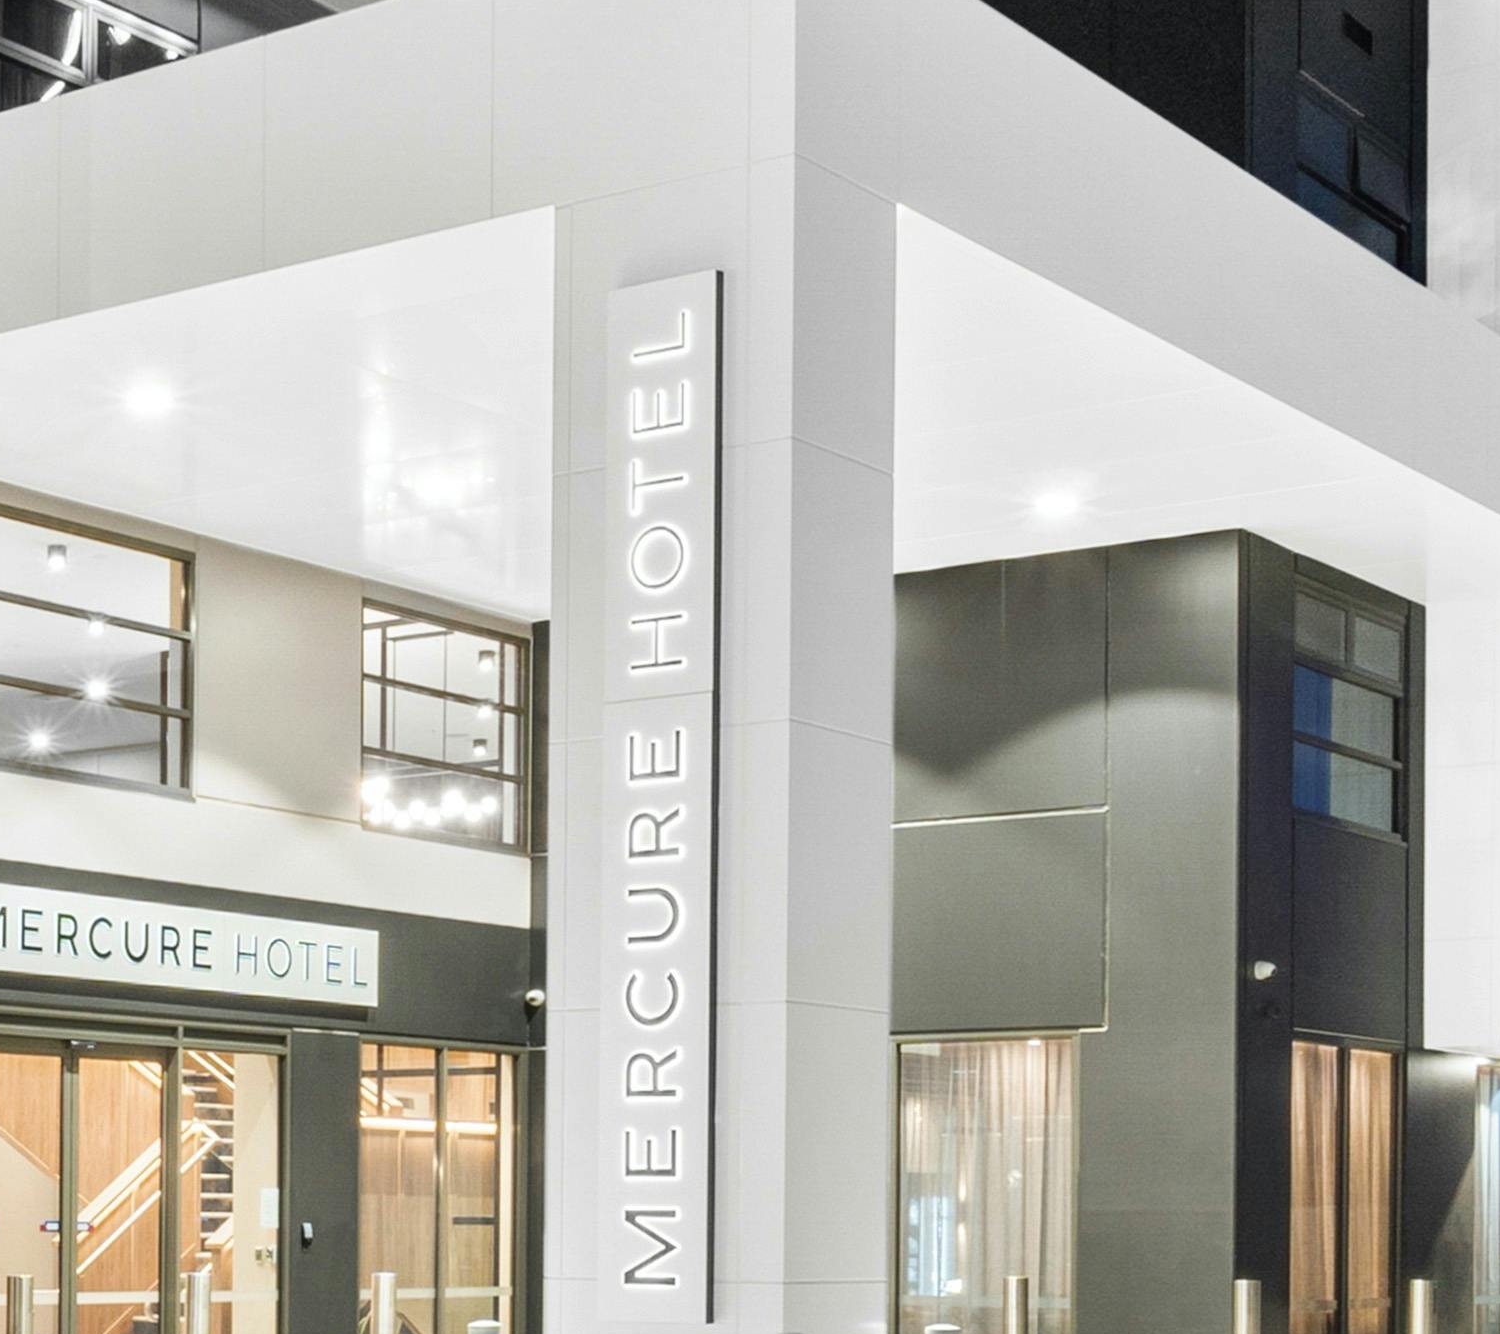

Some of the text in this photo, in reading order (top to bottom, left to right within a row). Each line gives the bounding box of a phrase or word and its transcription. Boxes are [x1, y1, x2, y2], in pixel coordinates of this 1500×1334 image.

[235, 933, 368, 987] HOTEL
[623, 310, 688, 1286] MERCURE HOTEL
